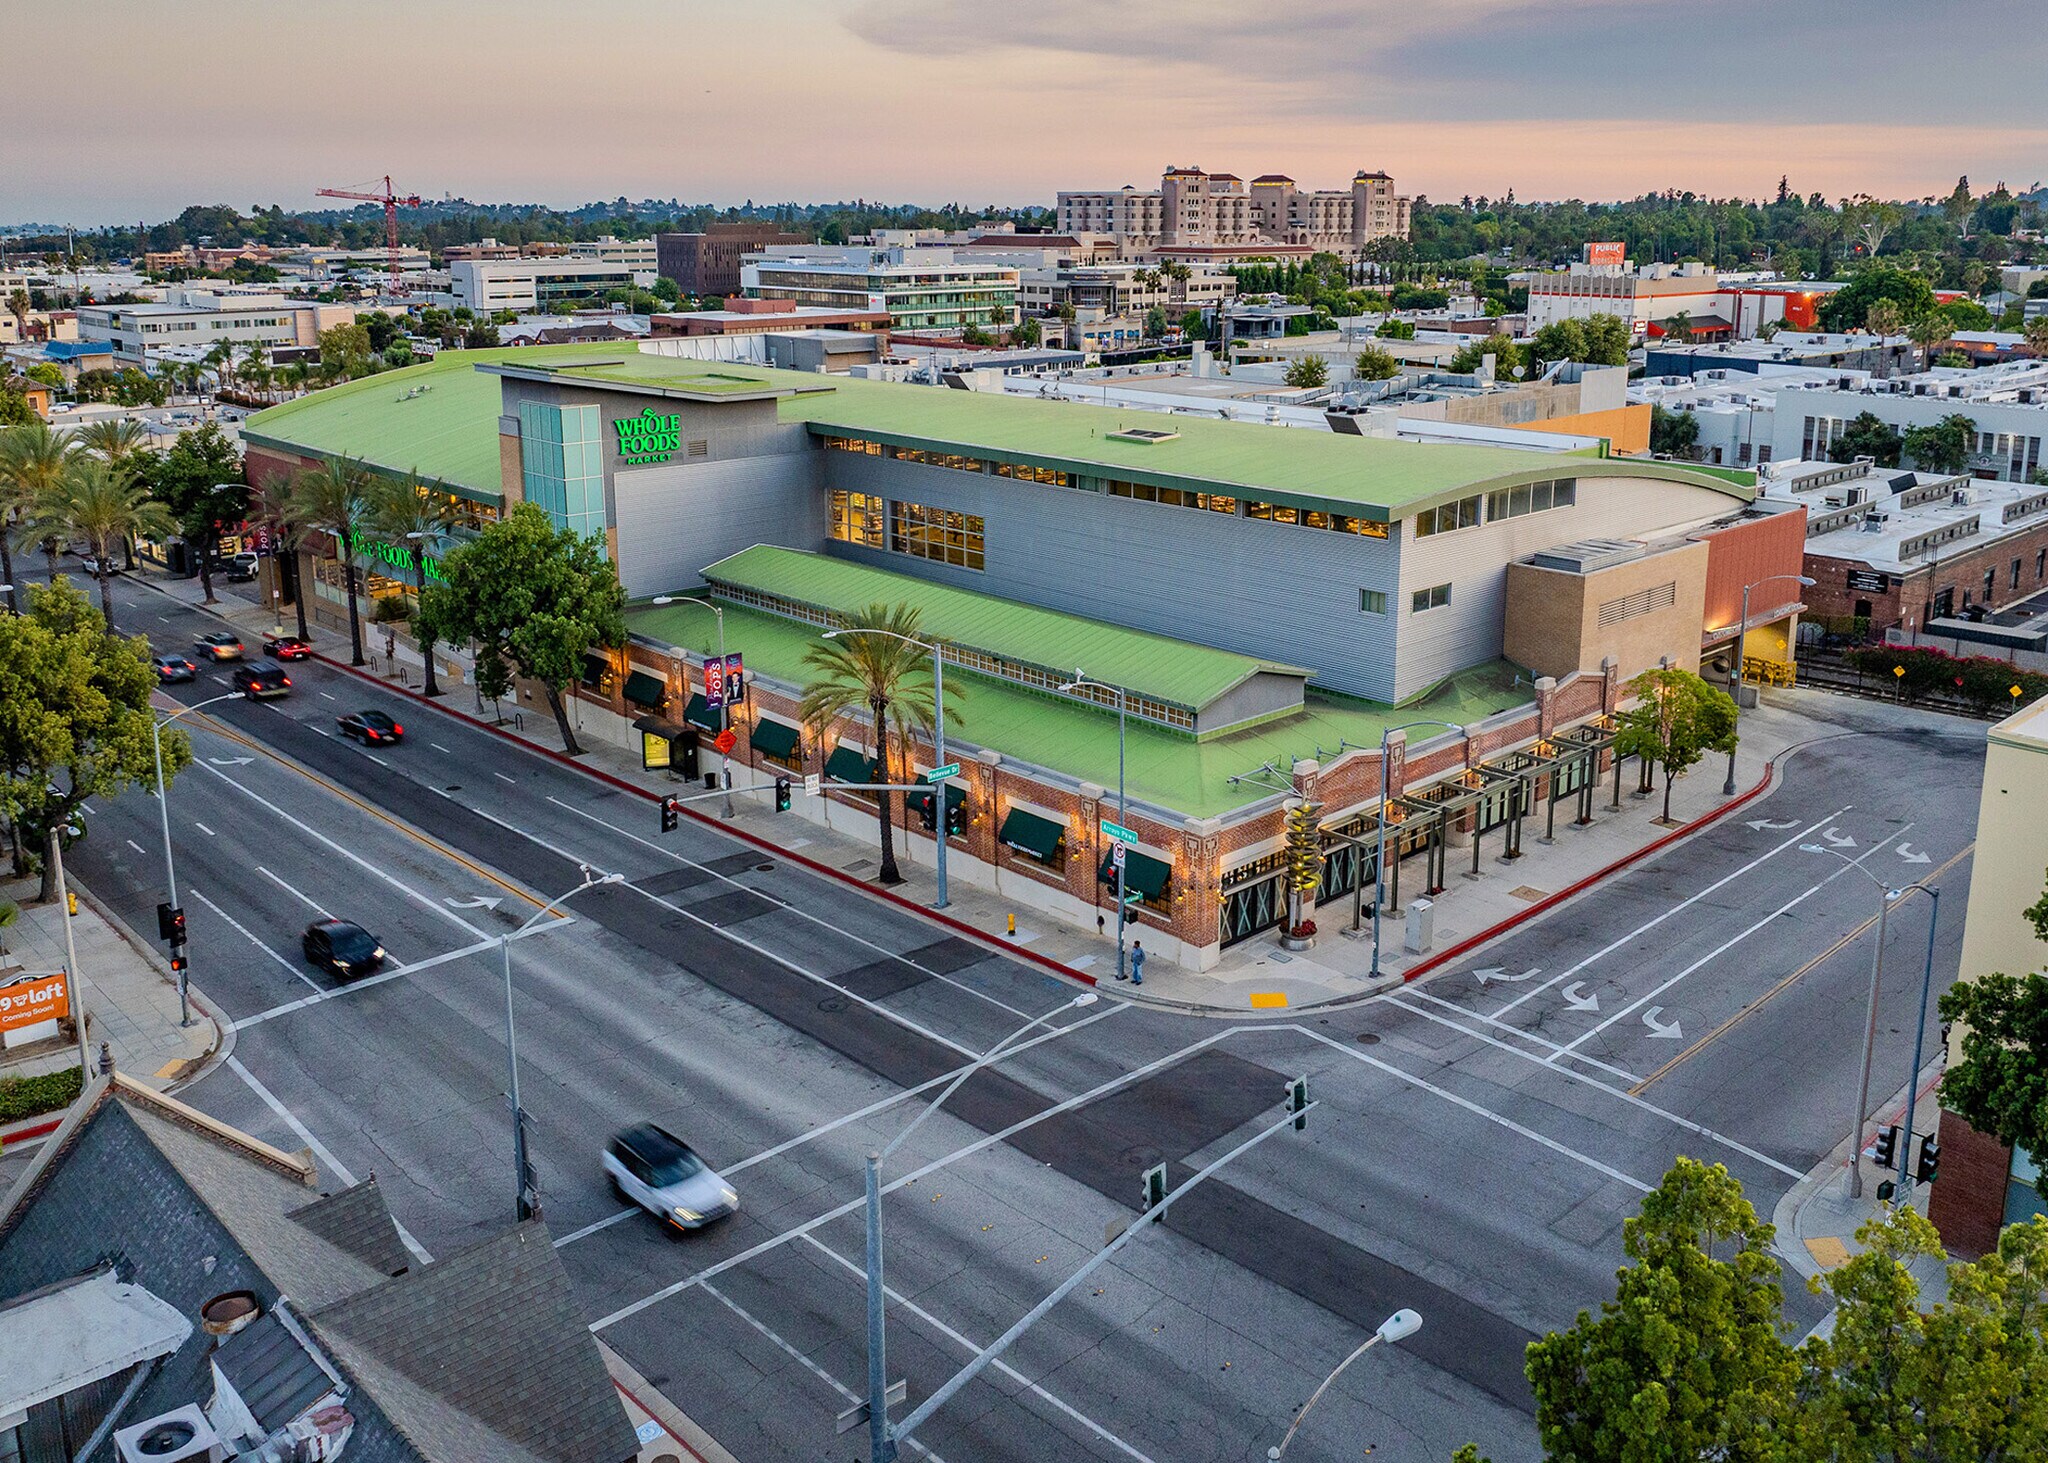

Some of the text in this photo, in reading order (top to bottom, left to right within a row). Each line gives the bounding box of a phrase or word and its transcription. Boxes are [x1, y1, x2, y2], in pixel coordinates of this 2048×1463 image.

[1595, 244, 1621, 254] PUBLIC
[614, 407, 682, 437] WHOLE
[619, 432, 681, 456] FOODS
[627, 453, 672, 465] MARKET
[260, 525, 269, 549] POPS
[376, 540, 414, 571] FOODS
[711, 663, 722, 698] POPS
[928, 766, 959, 780] Bellevue Dr
[0, 982, 64, 1012] 9 loft
[2, 1004, 55, 1023] Coming Soon!
